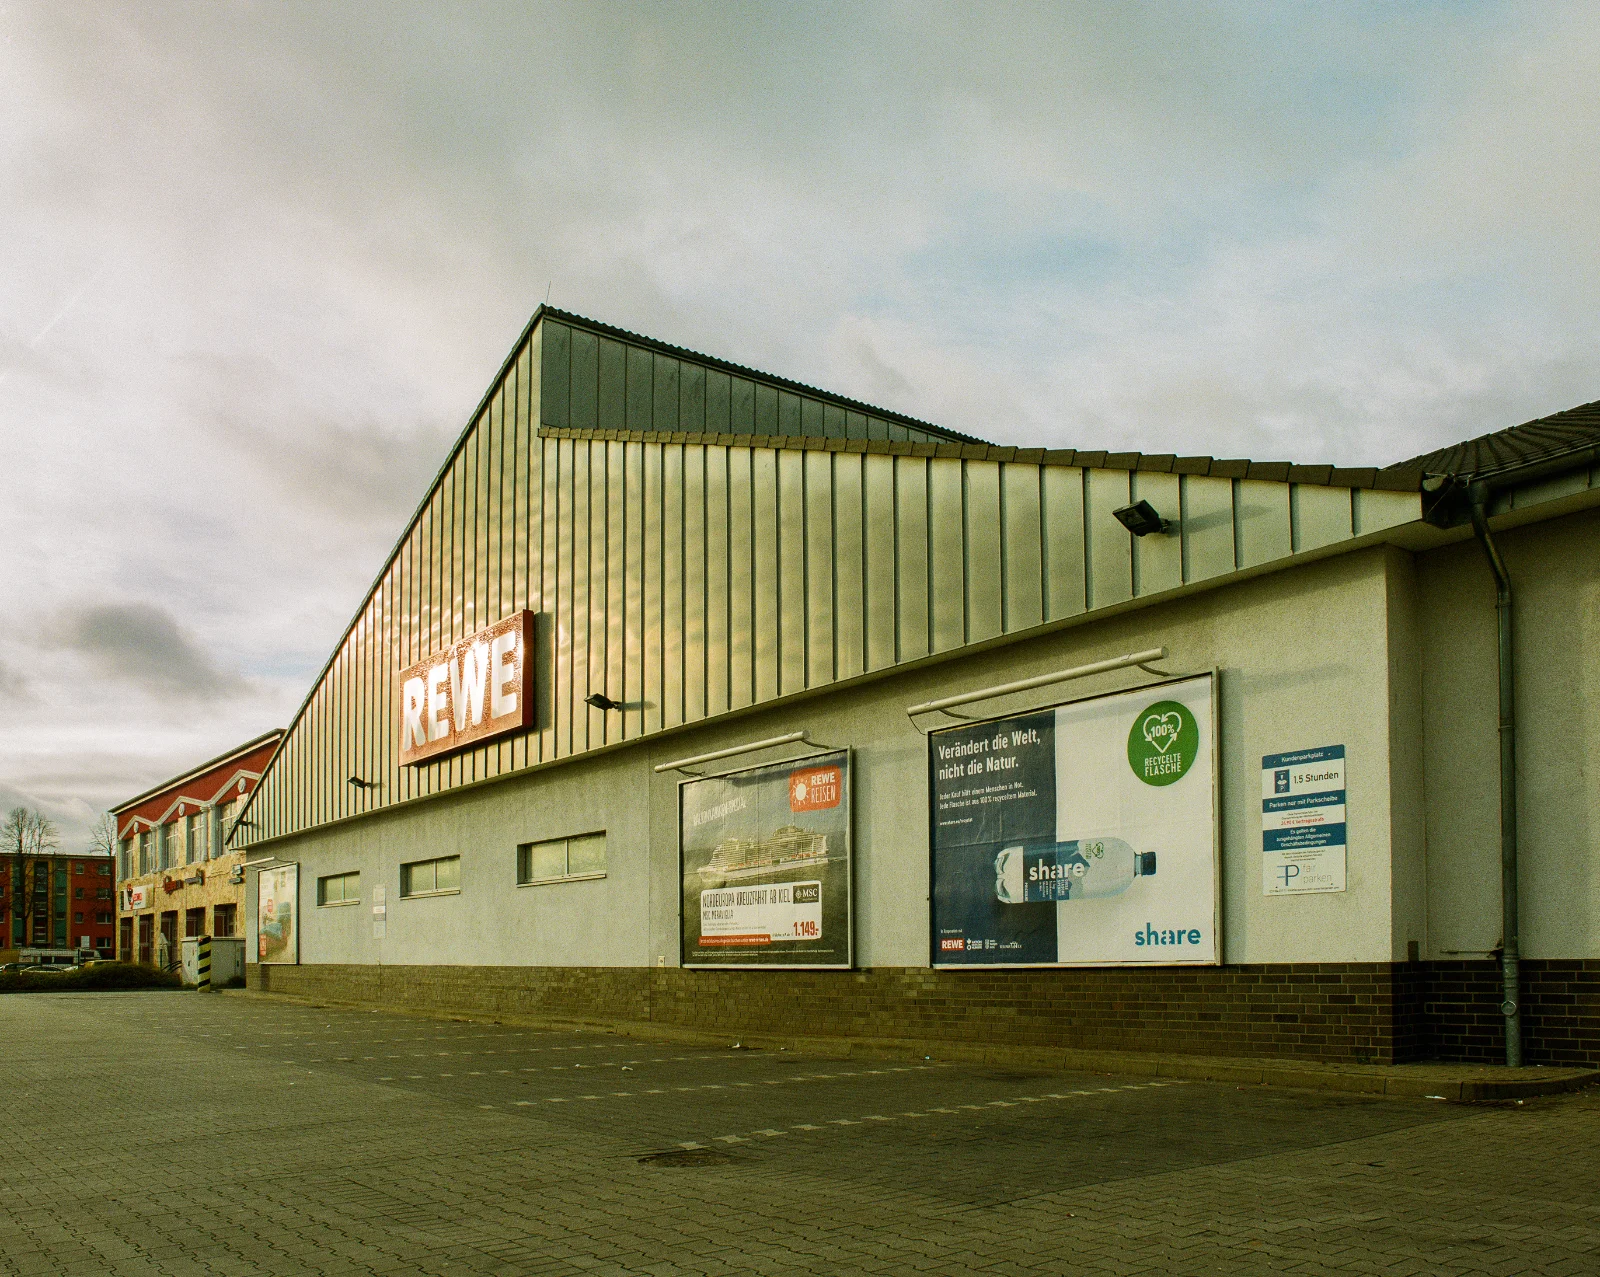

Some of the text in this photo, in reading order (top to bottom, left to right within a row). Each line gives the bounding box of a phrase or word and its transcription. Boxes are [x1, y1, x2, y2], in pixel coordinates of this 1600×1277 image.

[403, 630, 518, 752] REWE
[1151, 724, 1174, 738] 100%
[939, 728, 1040, 760] Verändert die Welt,
[1144, 753, 1181, 766] RECYCELTE
[1282, 752, 1324, 762] Kundenparkplatz
[940, 756, 1018, 780] nicht die Natur.
[1145, 762, 1181, 776] FLASCHE
[811, 772, 836, 786] REWE
[1306, 772, 1338, 782] Stunden
[811, 785, 836, 803] REISEN
[986, 784, 1008, 794] Menschen
[950, 800, 964, 808] Flasche
[1018, 789, 1038, 798] Material.
[1270, 800, 1286, 808] Parken
[1307, 796, 1337, 804] Parkscheibe
[1029, 858, 1085, 880] share
[1303, 874, 1331, 884] parken
[703, 888, 790, 908] NORDEUROPA KREUZFAHRT AB KIEL
[802, 888, 817, 897] MSC
[1135, 922, 1201, 946] share
[941, 940, 964, 949] REWE
